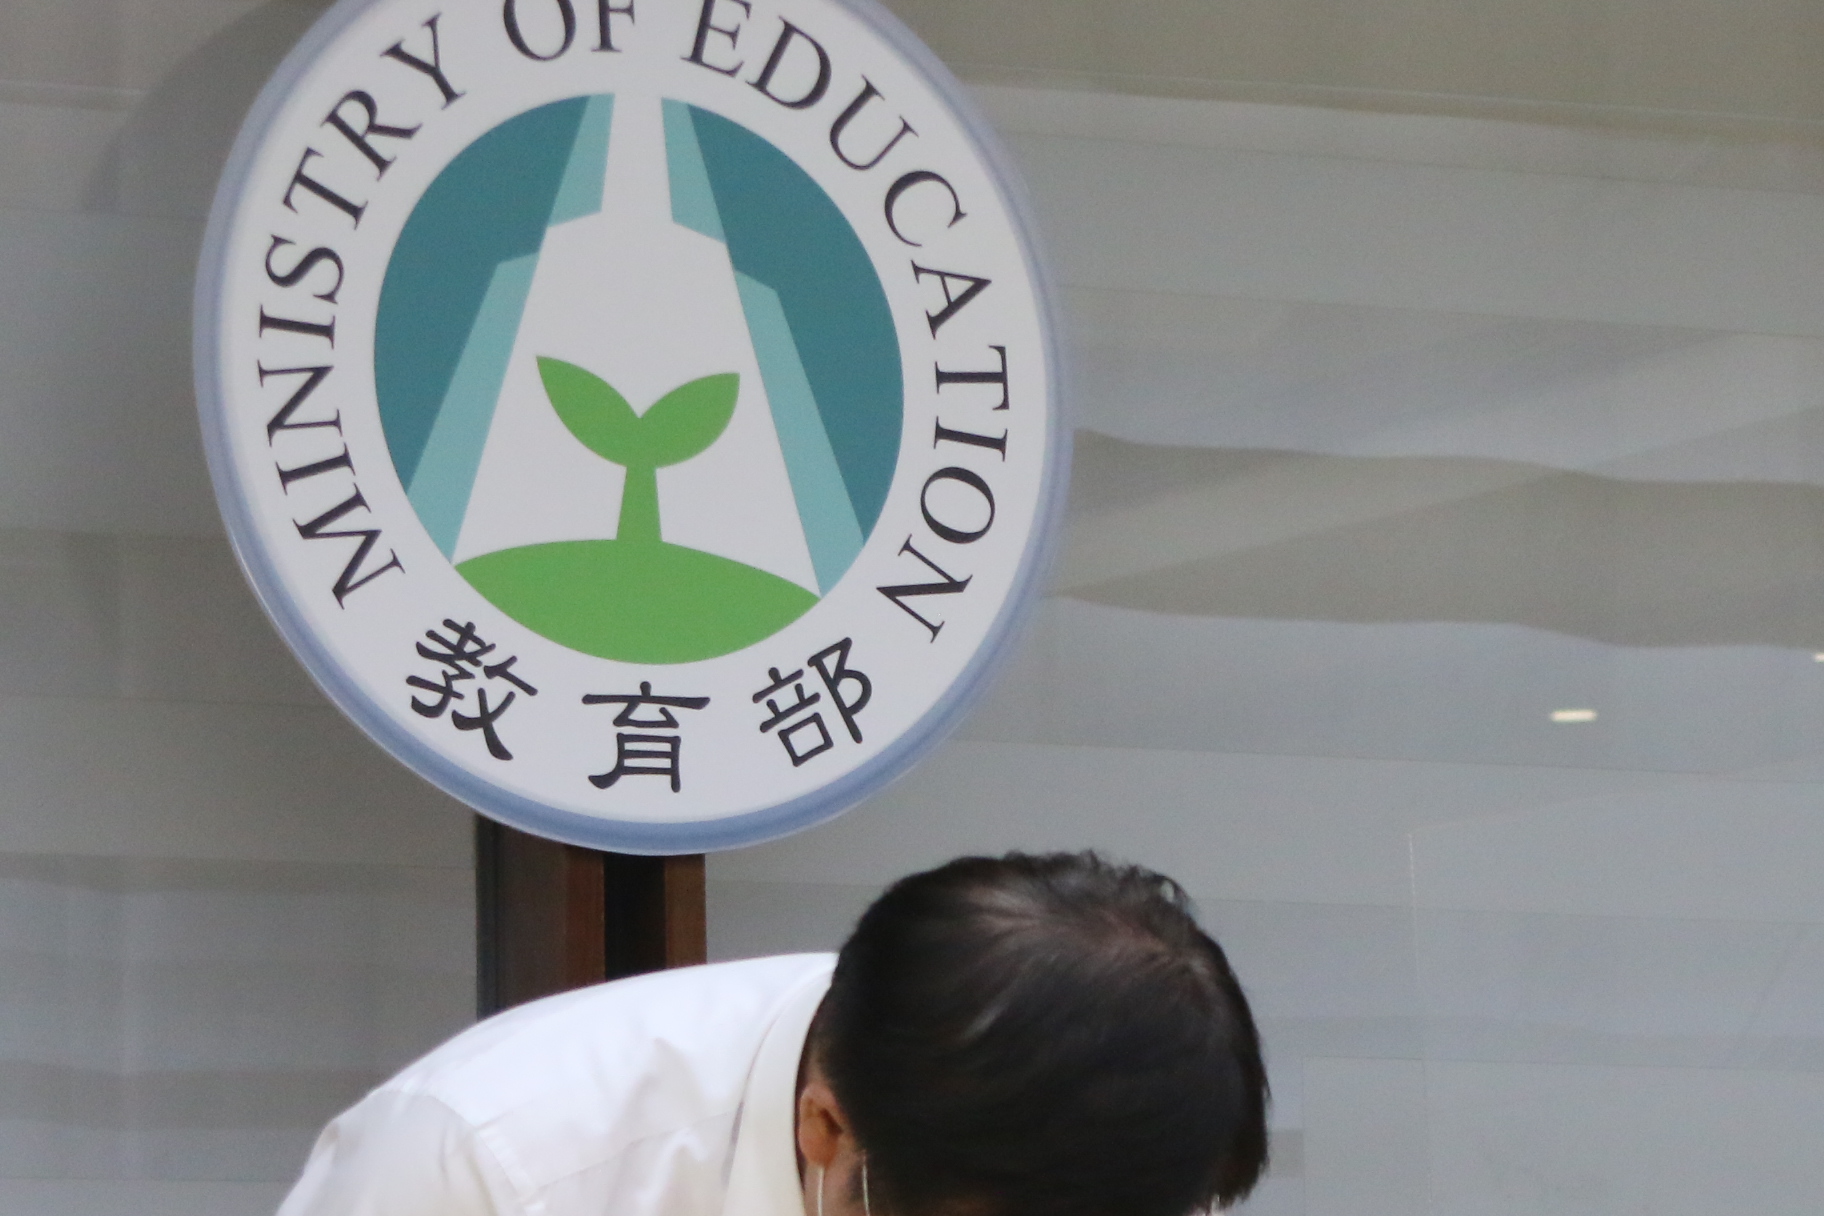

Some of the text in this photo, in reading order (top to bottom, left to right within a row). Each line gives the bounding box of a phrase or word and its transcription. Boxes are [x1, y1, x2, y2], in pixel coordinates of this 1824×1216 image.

[256, 0, 1012, 644] MINISTRY OF EDUCATION
[405, 616, 874, 794] 教育部
